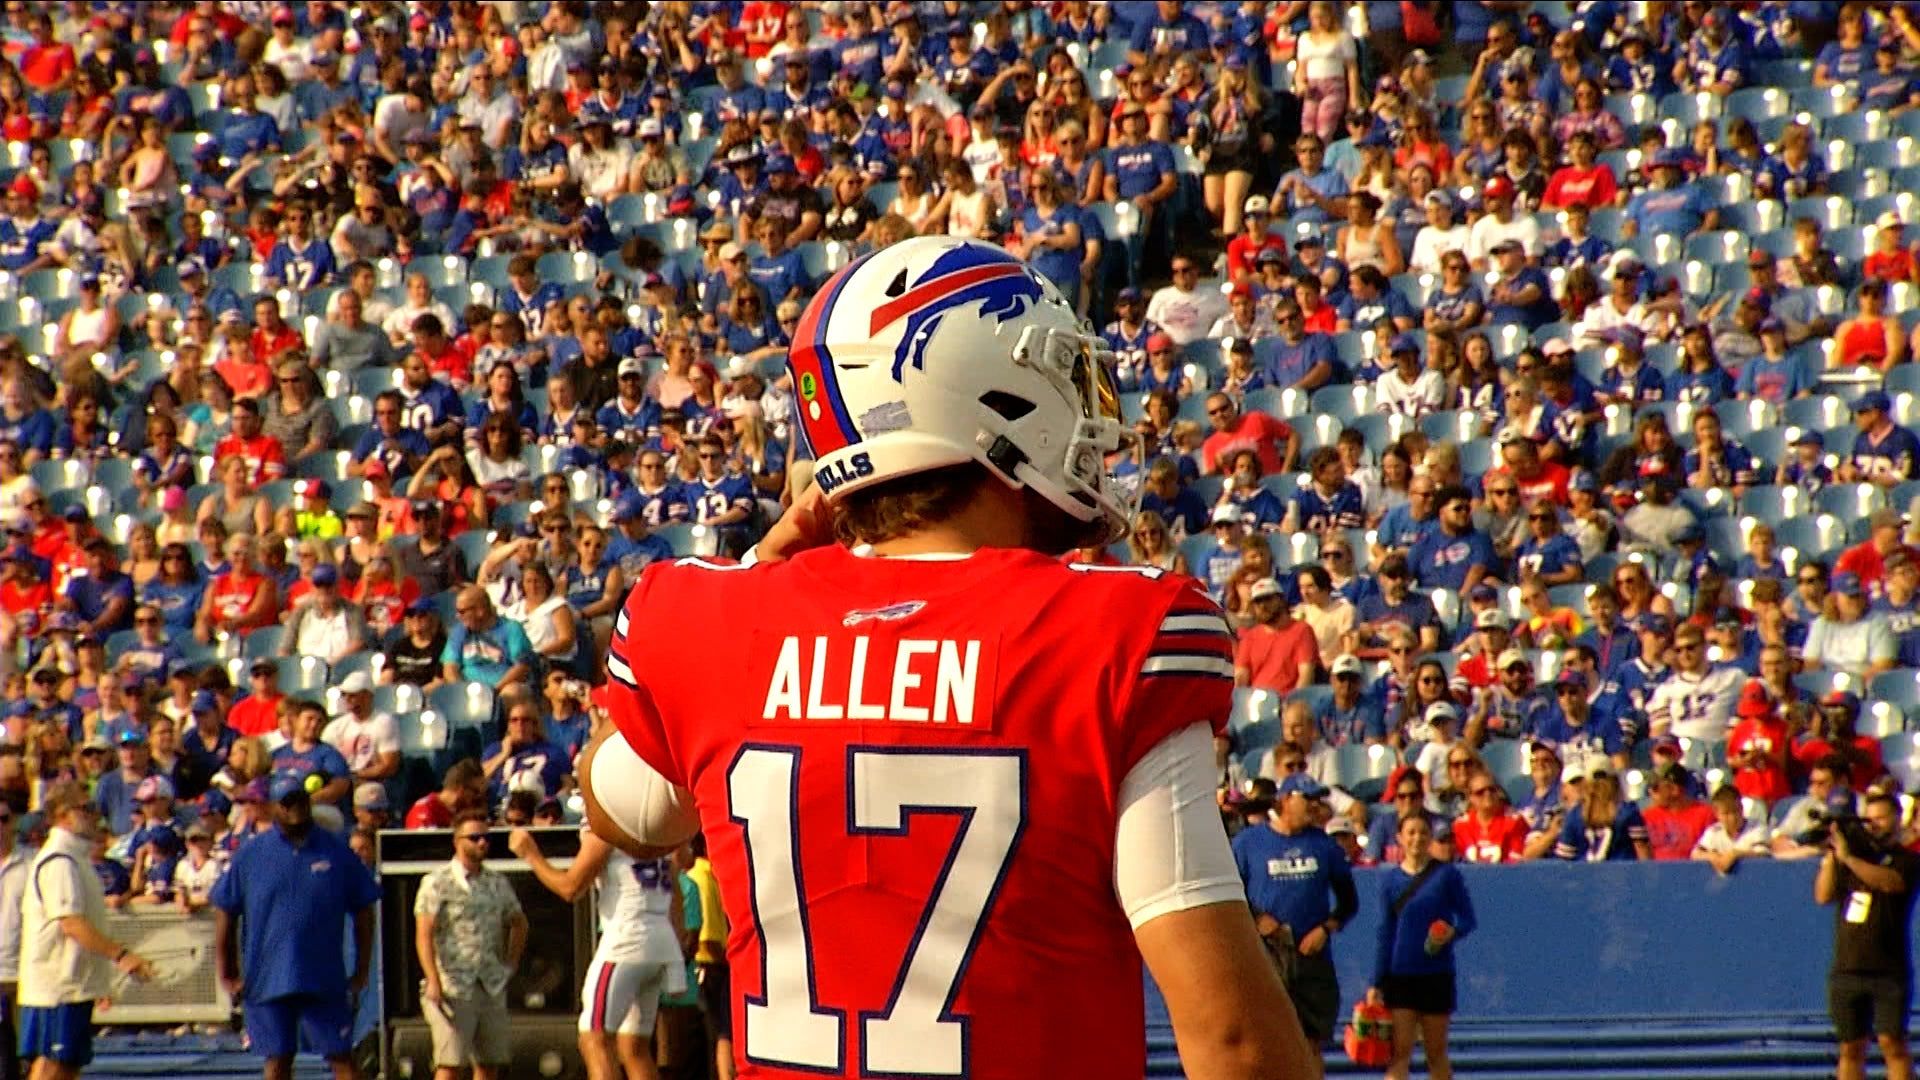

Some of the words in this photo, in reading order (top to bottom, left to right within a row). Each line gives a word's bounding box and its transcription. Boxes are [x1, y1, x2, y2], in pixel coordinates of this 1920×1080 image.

[286, 262, 313, 291] 17
[1459, 384, 1493, 409] 14
[762, 635, 981, 724] ALLEN
[726, 742, 1029, 1078] 17
